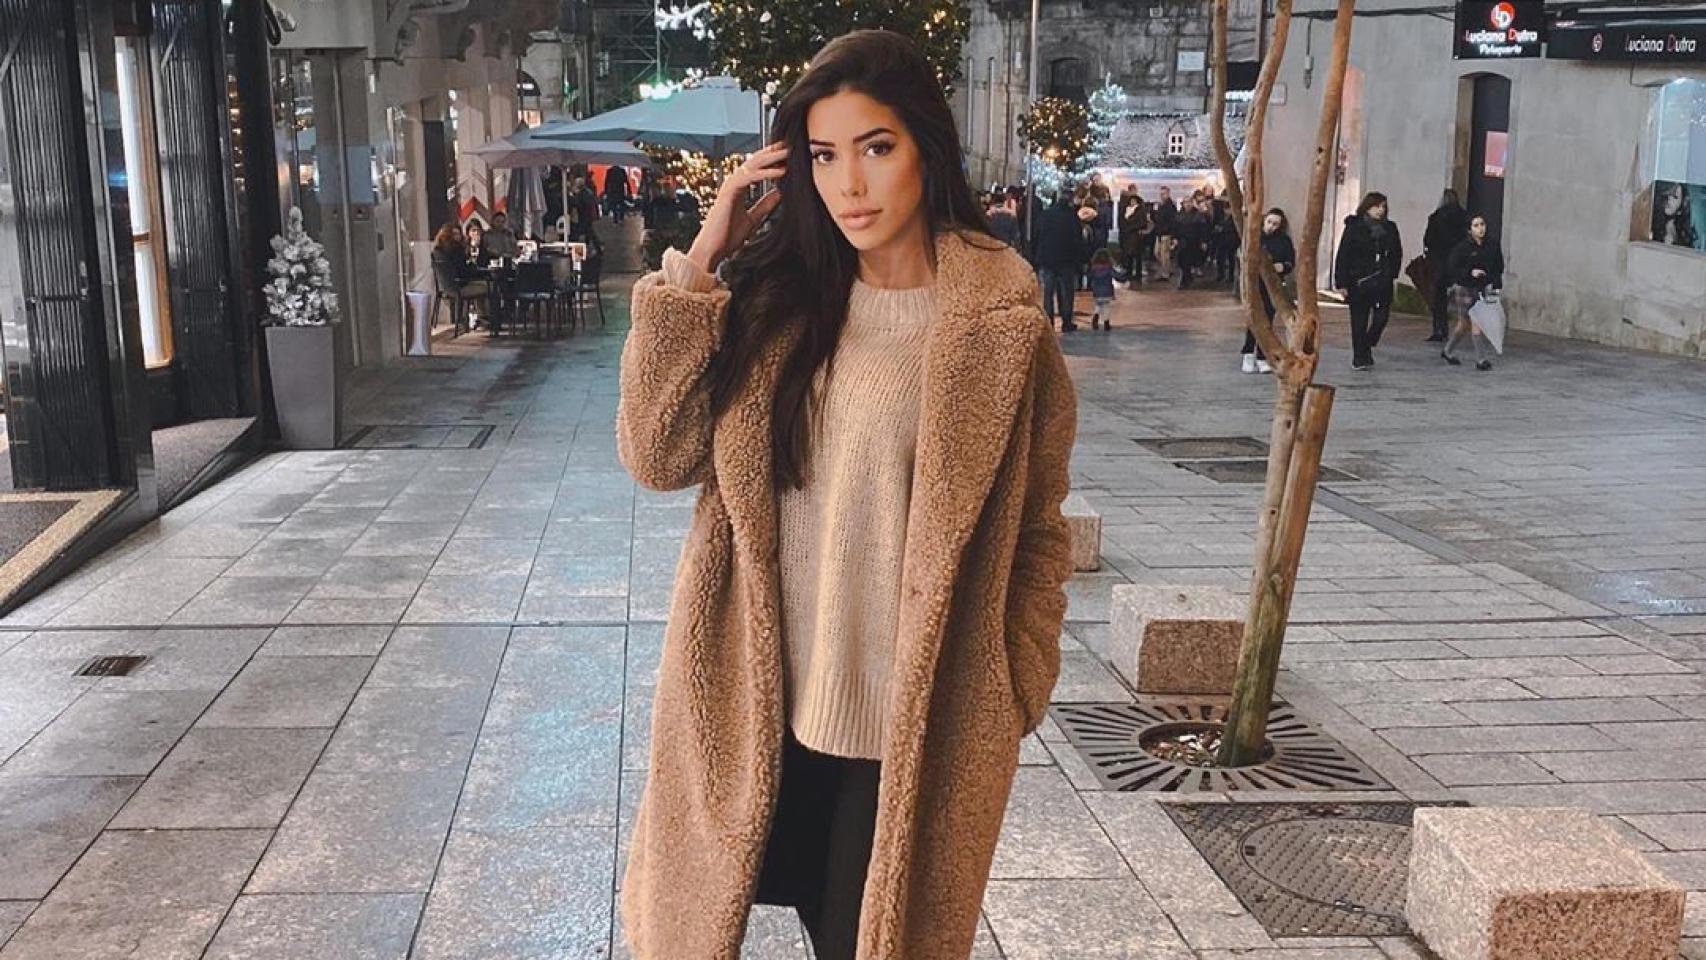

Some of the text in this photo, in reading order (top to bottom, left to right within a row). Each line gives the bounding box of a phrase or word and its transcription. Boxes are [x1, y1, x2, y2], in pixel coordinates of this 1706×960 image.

[1465, 28, 1538, 42] Luciana Dutra
[1625, 33, 1664, 53] Luciana
